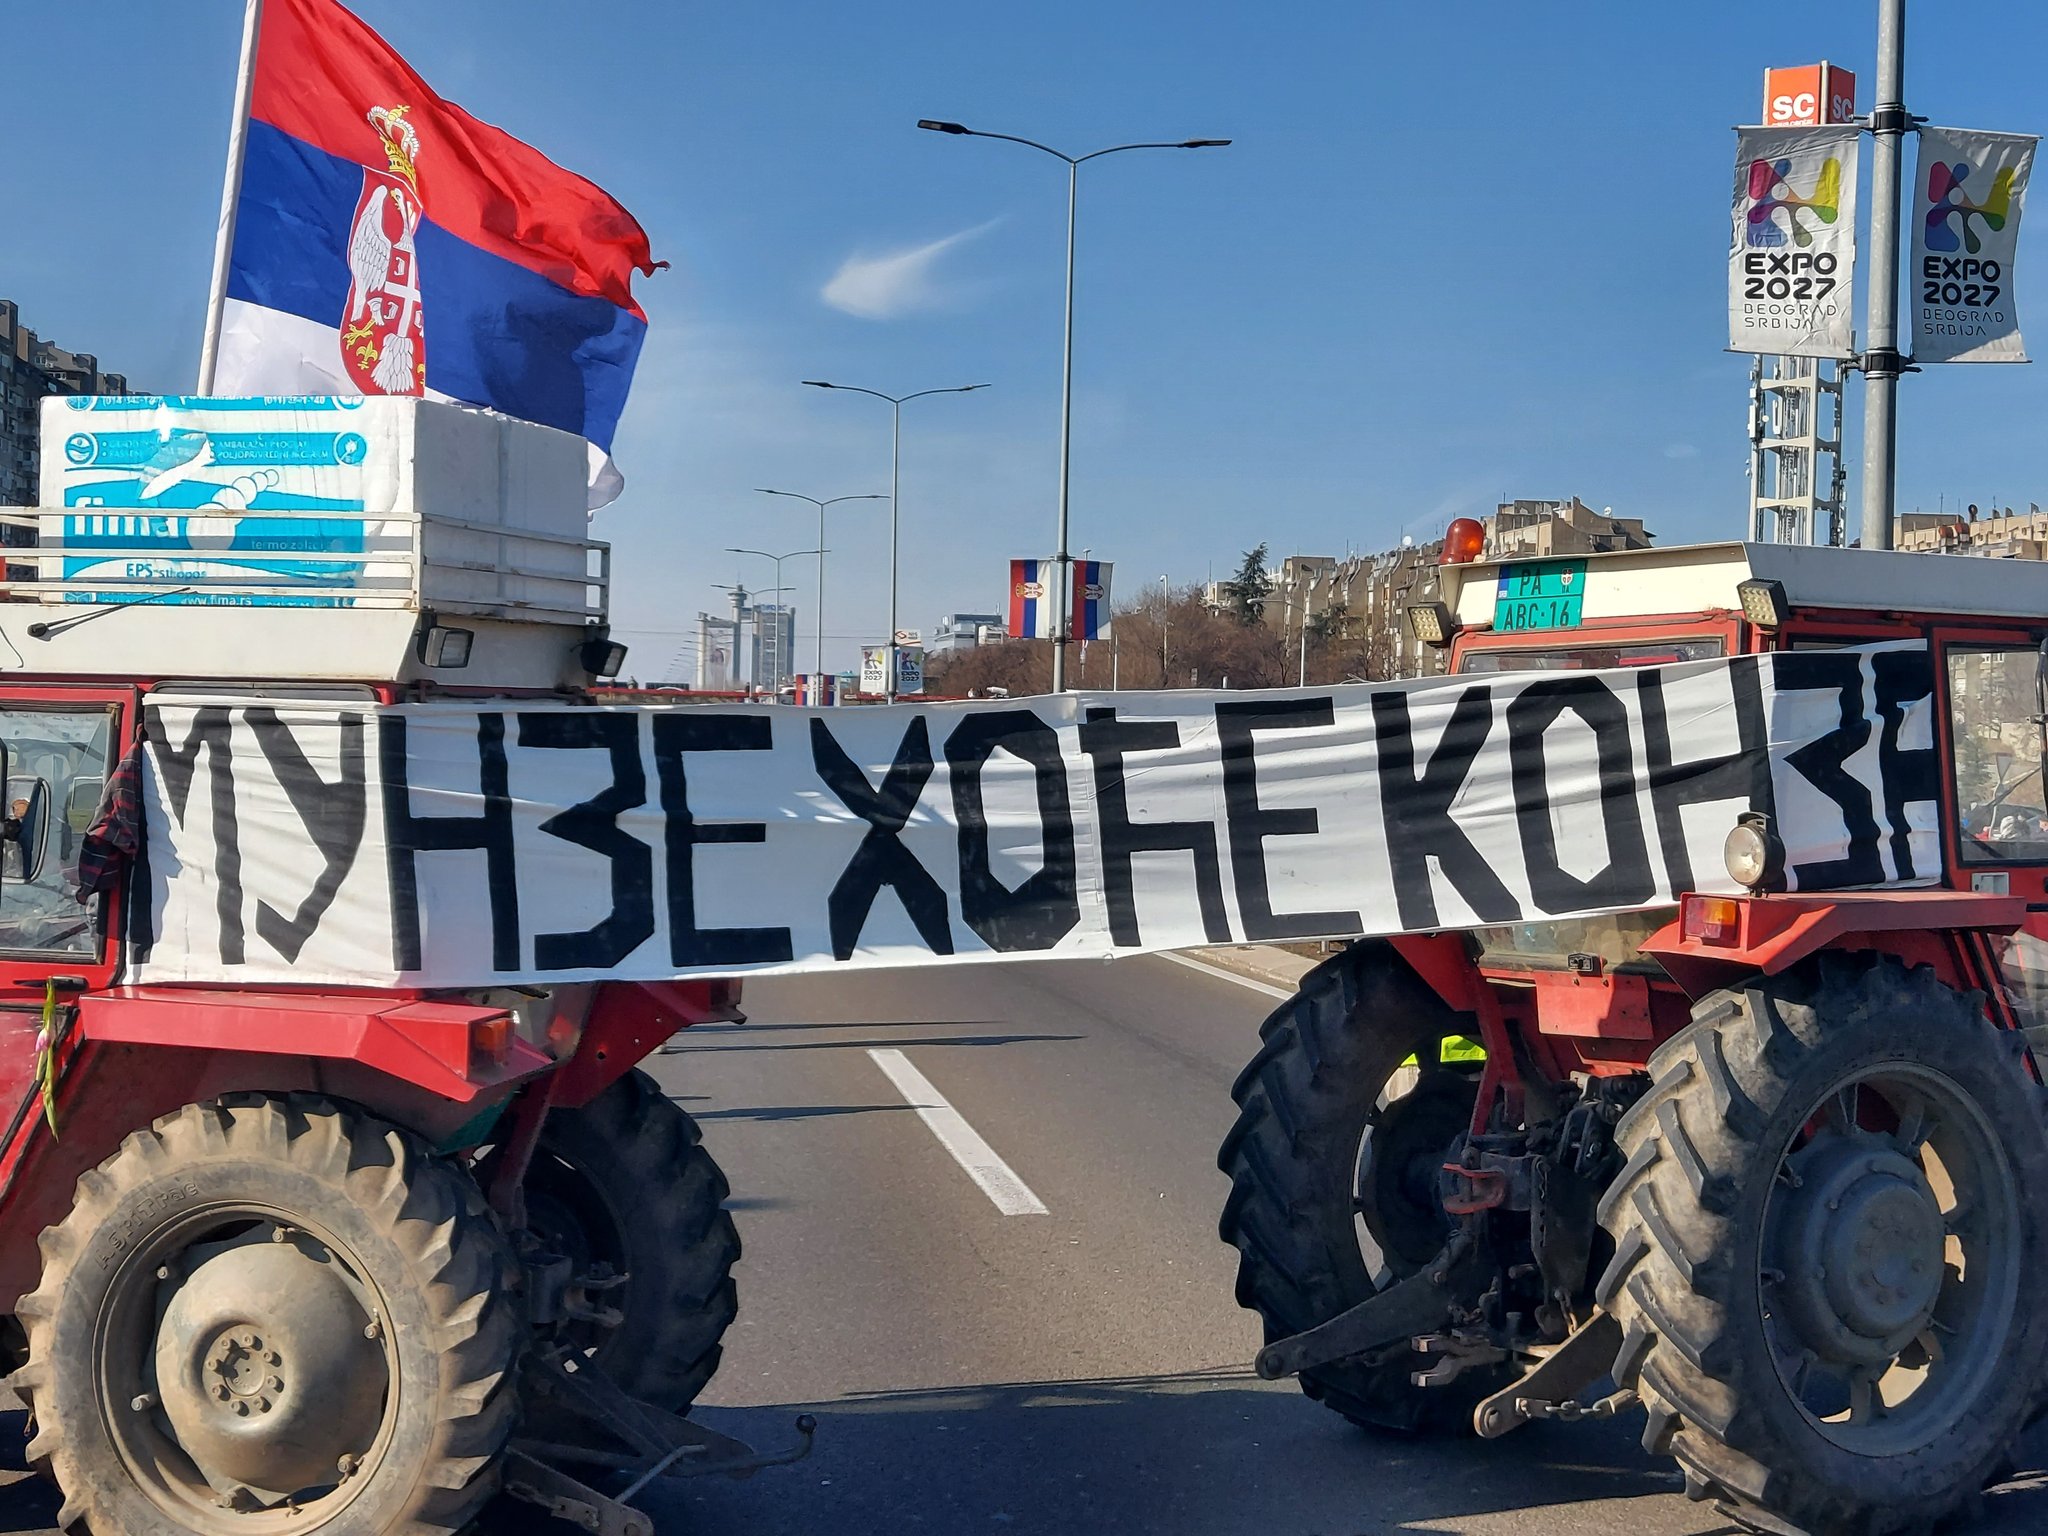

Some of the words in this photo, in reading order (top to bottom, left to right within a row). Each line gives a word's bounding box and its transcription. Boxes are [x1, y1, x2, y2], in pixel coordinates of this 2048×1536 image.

[1772, 93, 1815, 120] SC
[1832, 94, 1852, 123] SC
[1745, 253, 1837, 275] EXPO
[1923, 256, 2001, 282] EXPO
[1744, 278, 1836, 299] 2027
[1922, 283, 2001, 308] 2027
[1744, 303, 1837, 316] BEOGRAD
[1923, 308, 2005, 323] BEOGRAD
[1745, 317, 1814, 329] SRBIJA
[1925, 323, 1987, 336] SRBIJA
[1519, 568, 1542, 596] PA
[129, 704, 793, 971] МУНЗЕ
[810, 693, 1363, 960] ХОЋЕ
